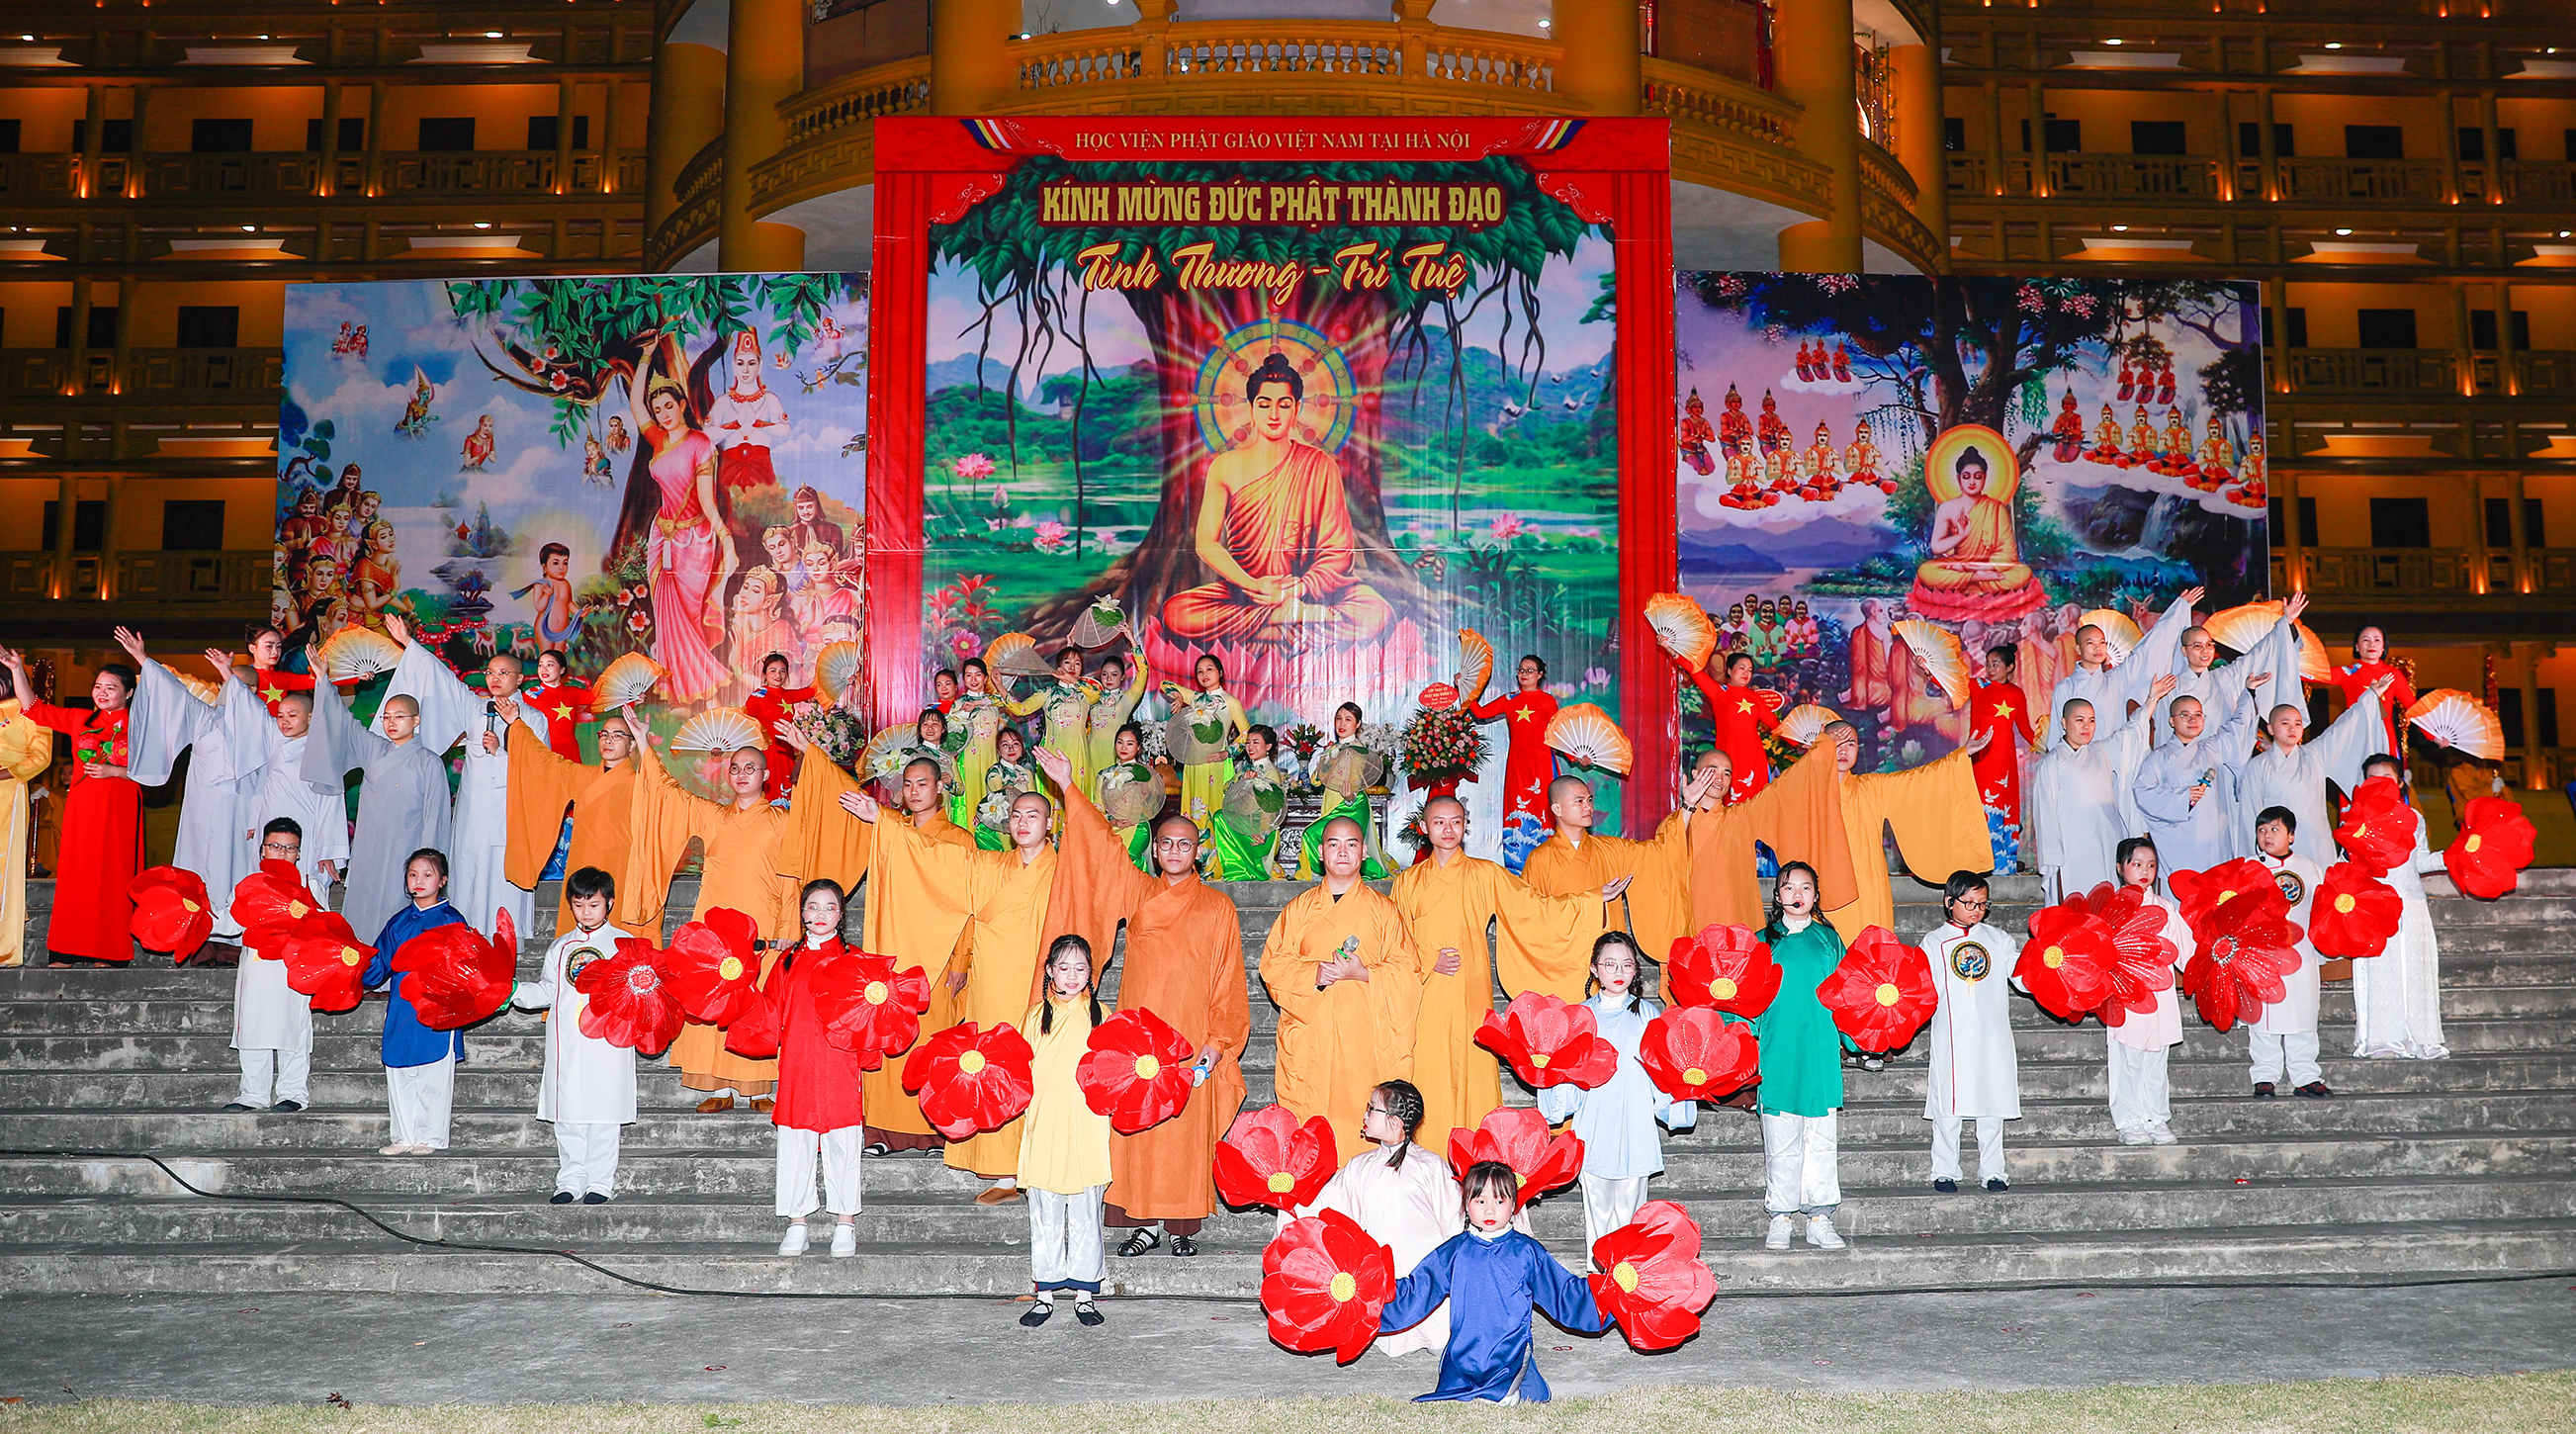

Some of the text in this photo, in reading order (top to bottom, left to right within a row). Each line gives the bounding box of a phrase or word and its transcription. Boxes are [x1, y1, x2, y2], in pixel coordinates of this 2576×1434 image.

[1076, 129, 1470, 151] HỌC VIỆN PHẬT GIÁO VIỆT NAM TẠI HÀ NỘI
[1043, 179, 1501, 228] KÍNH MỪNG ĐỨC PHẬT THÀNH ĐẠO
[1171, 240, 1305, 306] Thương
[1334, 241, 1390, 291] Trí
[1402, 241, 1466, 299] Tuệ
